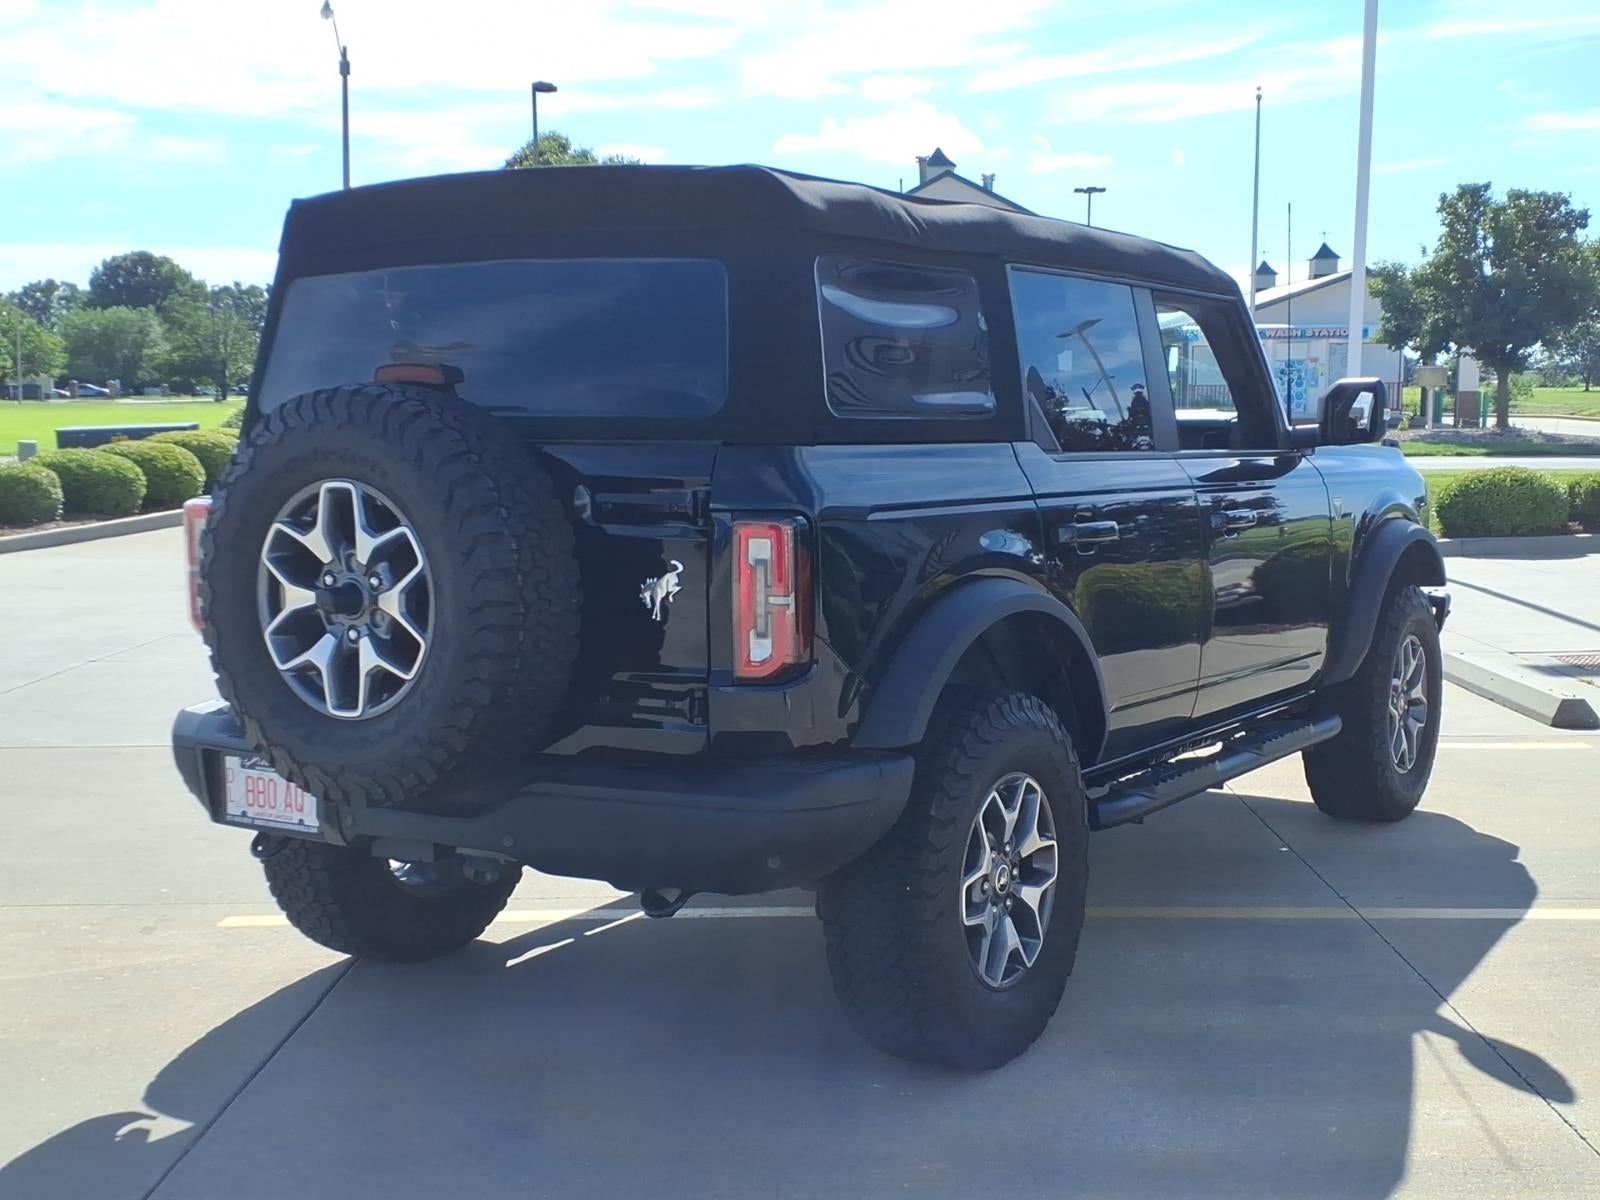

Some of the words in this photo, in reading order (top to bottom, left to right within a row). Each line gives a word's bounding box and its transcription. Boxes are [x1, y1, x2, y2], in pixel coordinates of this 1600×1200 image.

[1265, 328, 1302, 338] WASH
[1305, 327, 1349, 337] STATIO
[245, 775, 277, 809] 880
